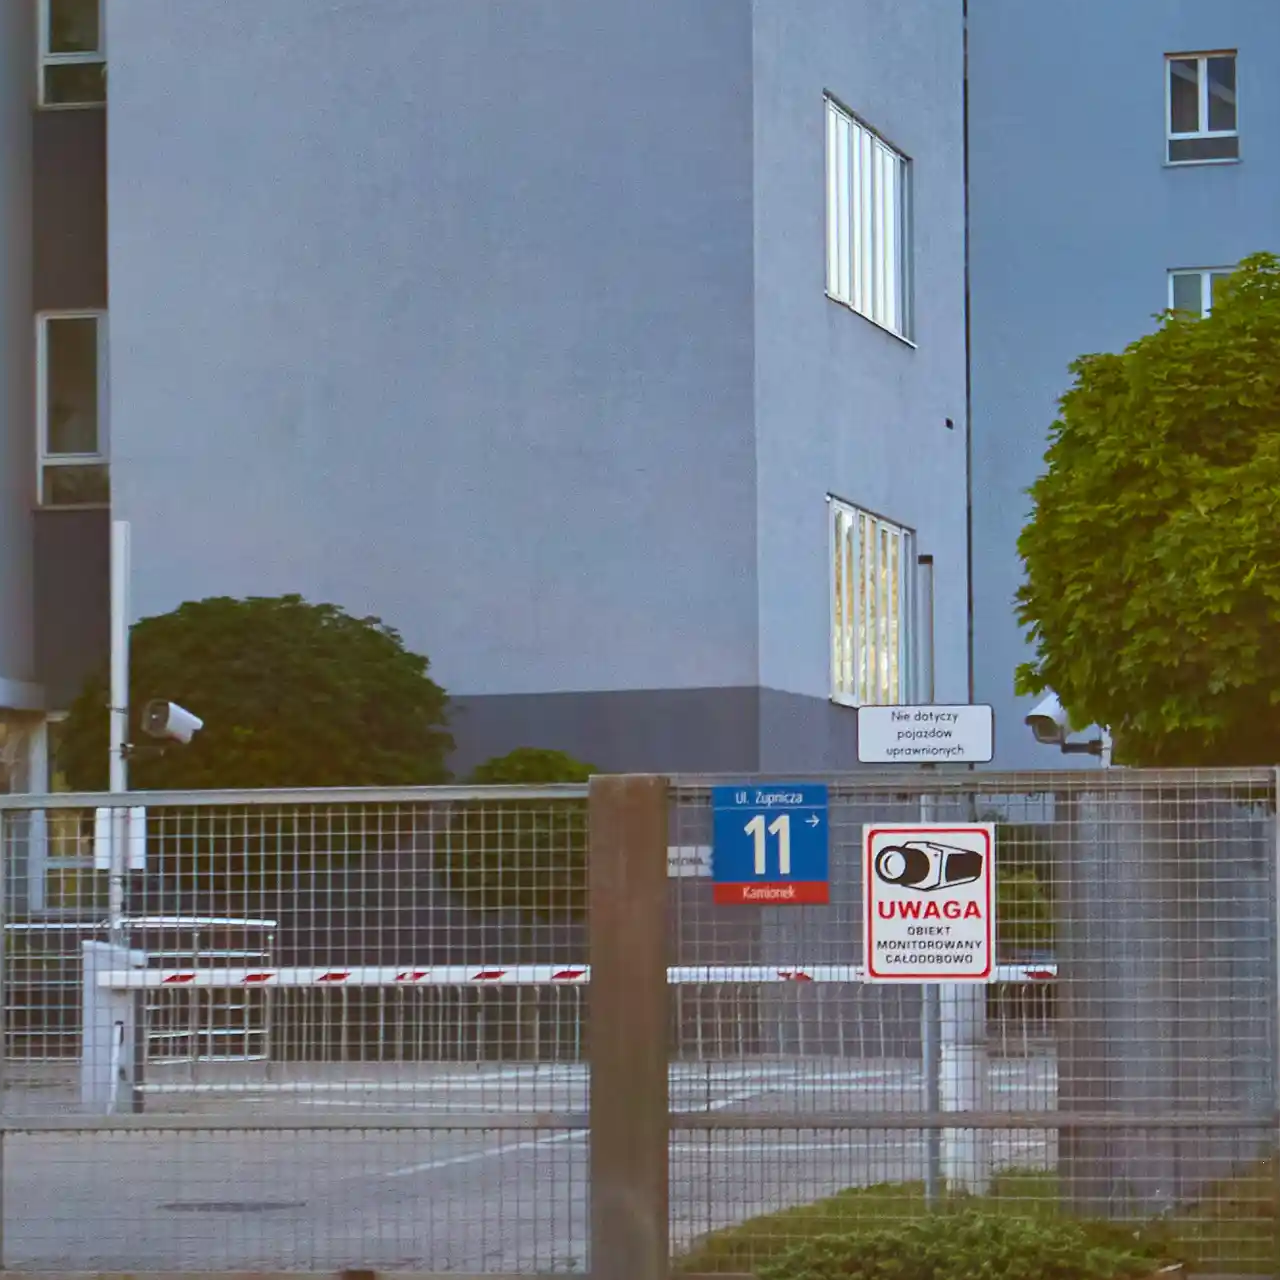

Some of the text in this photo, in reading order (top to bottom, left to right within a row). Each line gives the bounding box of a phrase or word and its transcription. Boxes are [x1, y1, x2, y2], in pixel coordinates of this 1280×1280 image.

[891, 710, 959, 724] Nie dotyczy
[886, 744, 965, 758] uprawnionych
[743, 814, 790, 874] 11
[878, 900, 982, 919] UWAGA
[907, 926, 951, 936] OBIEKT
[877, 940, 982, 950] MONITOROWANY
